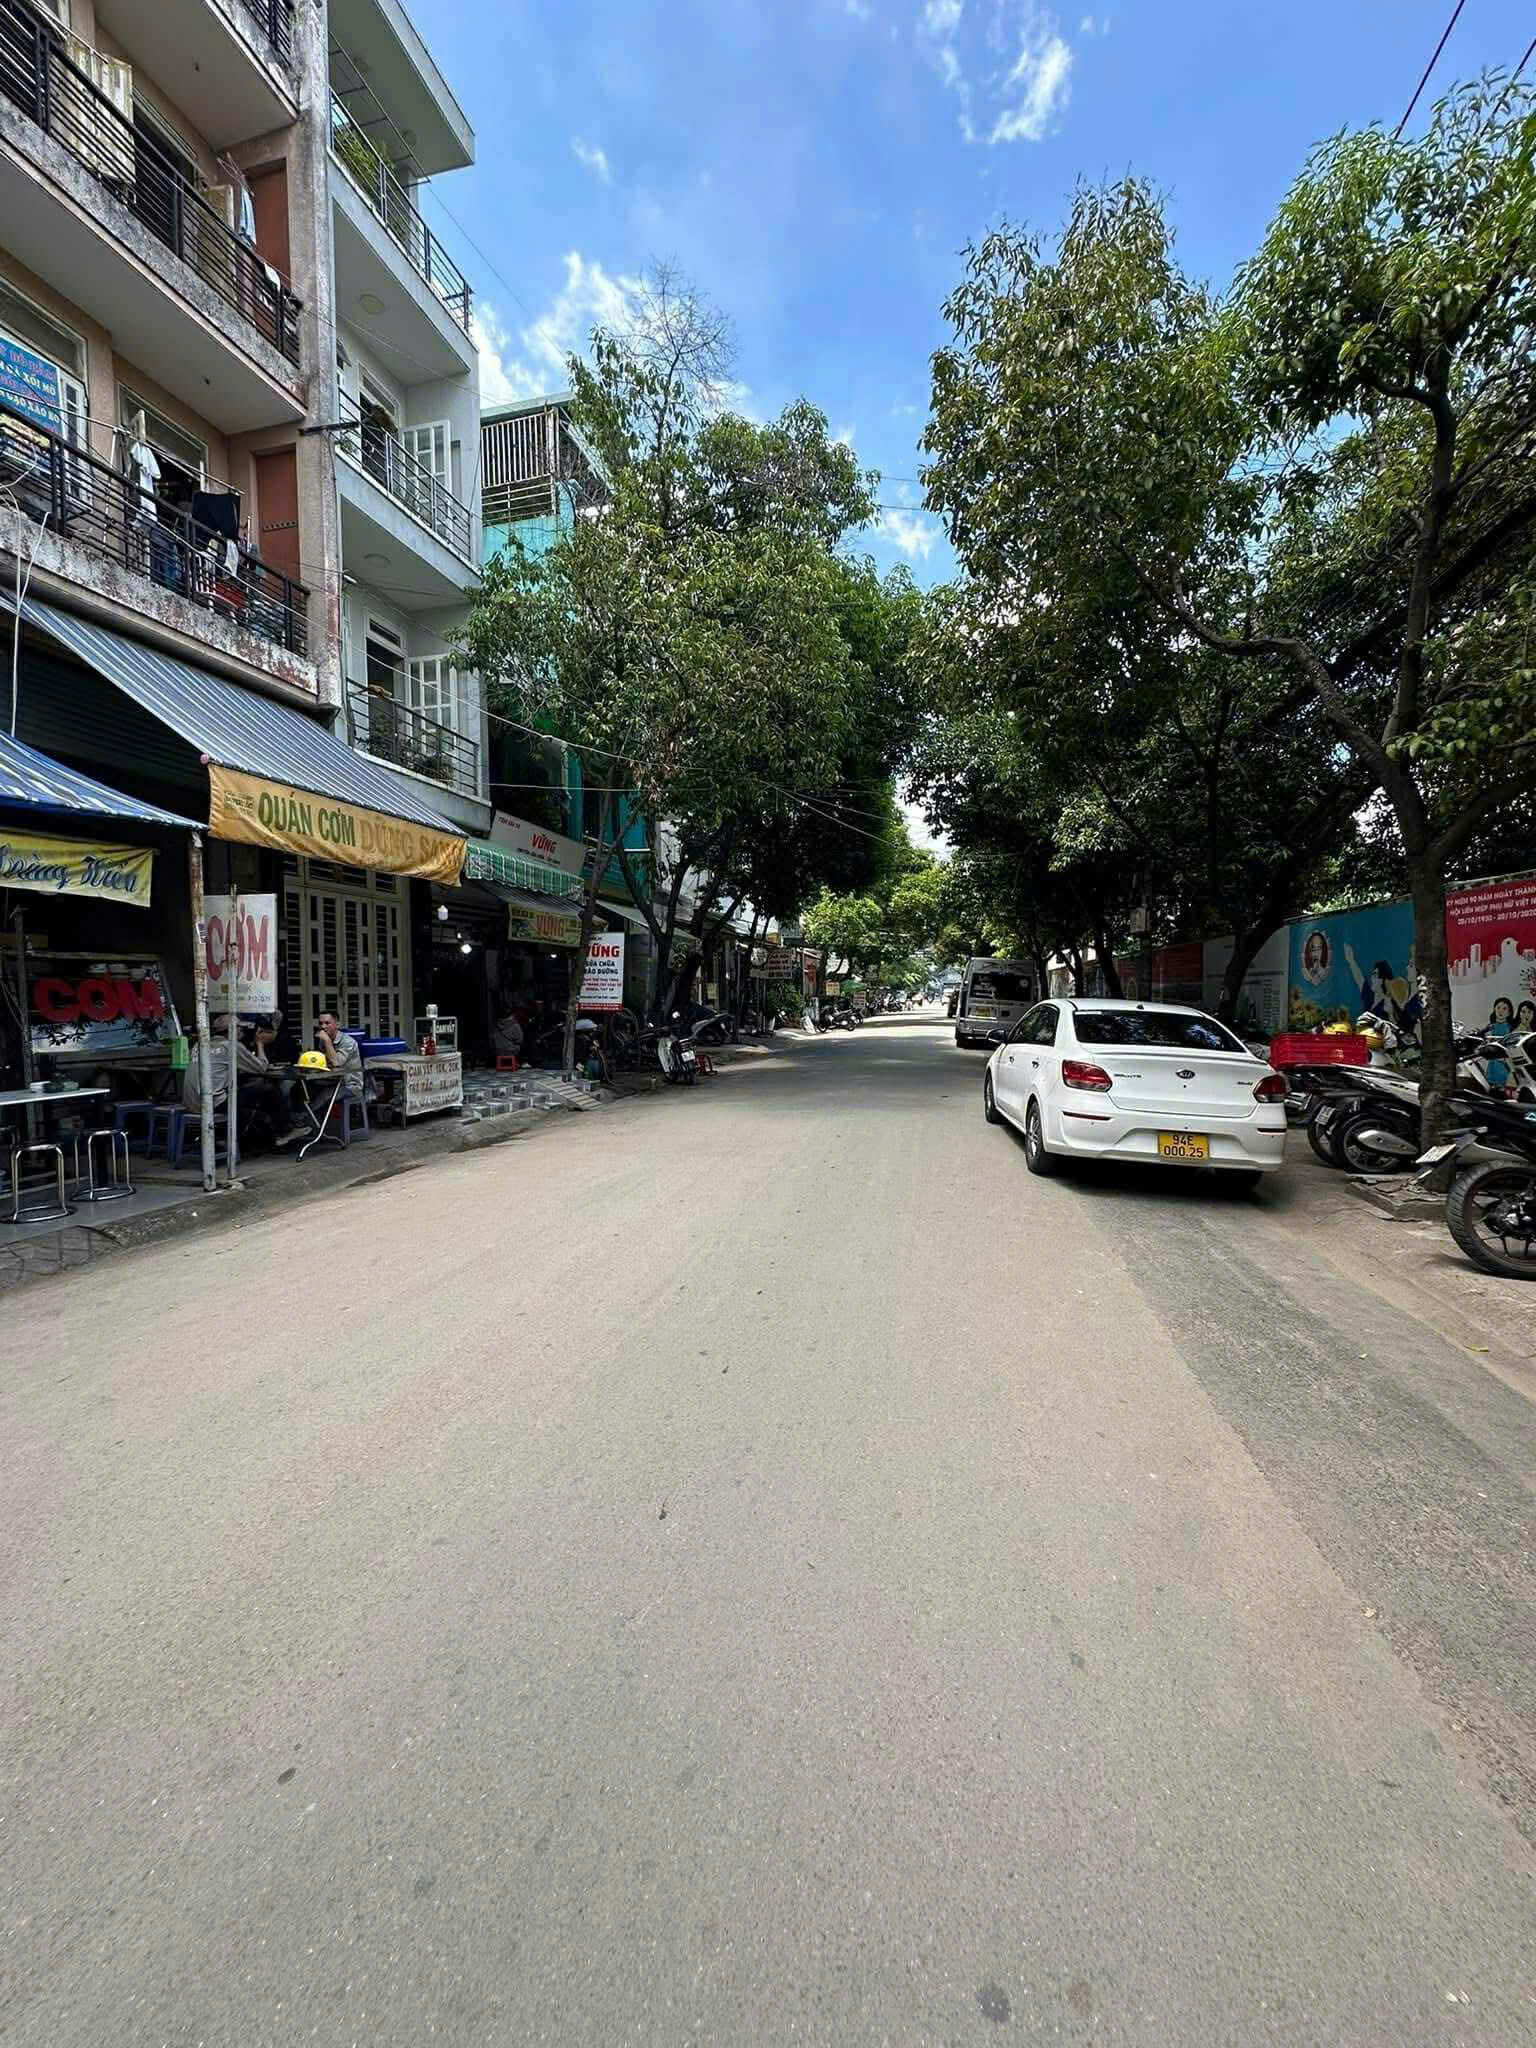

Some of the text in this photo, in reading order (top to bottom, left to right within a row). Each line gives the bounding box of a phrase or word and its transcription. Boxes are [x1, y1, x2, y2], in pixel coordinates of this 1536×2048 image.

[258, 791, 313, 836] QUÁN
[318, 807, 356, 847] CƠM
[208, 903, 269, 981] CƠM
[33, 970, 164, 1022] CƠM
[1163, 1145, 1204, 1159] 000.25
